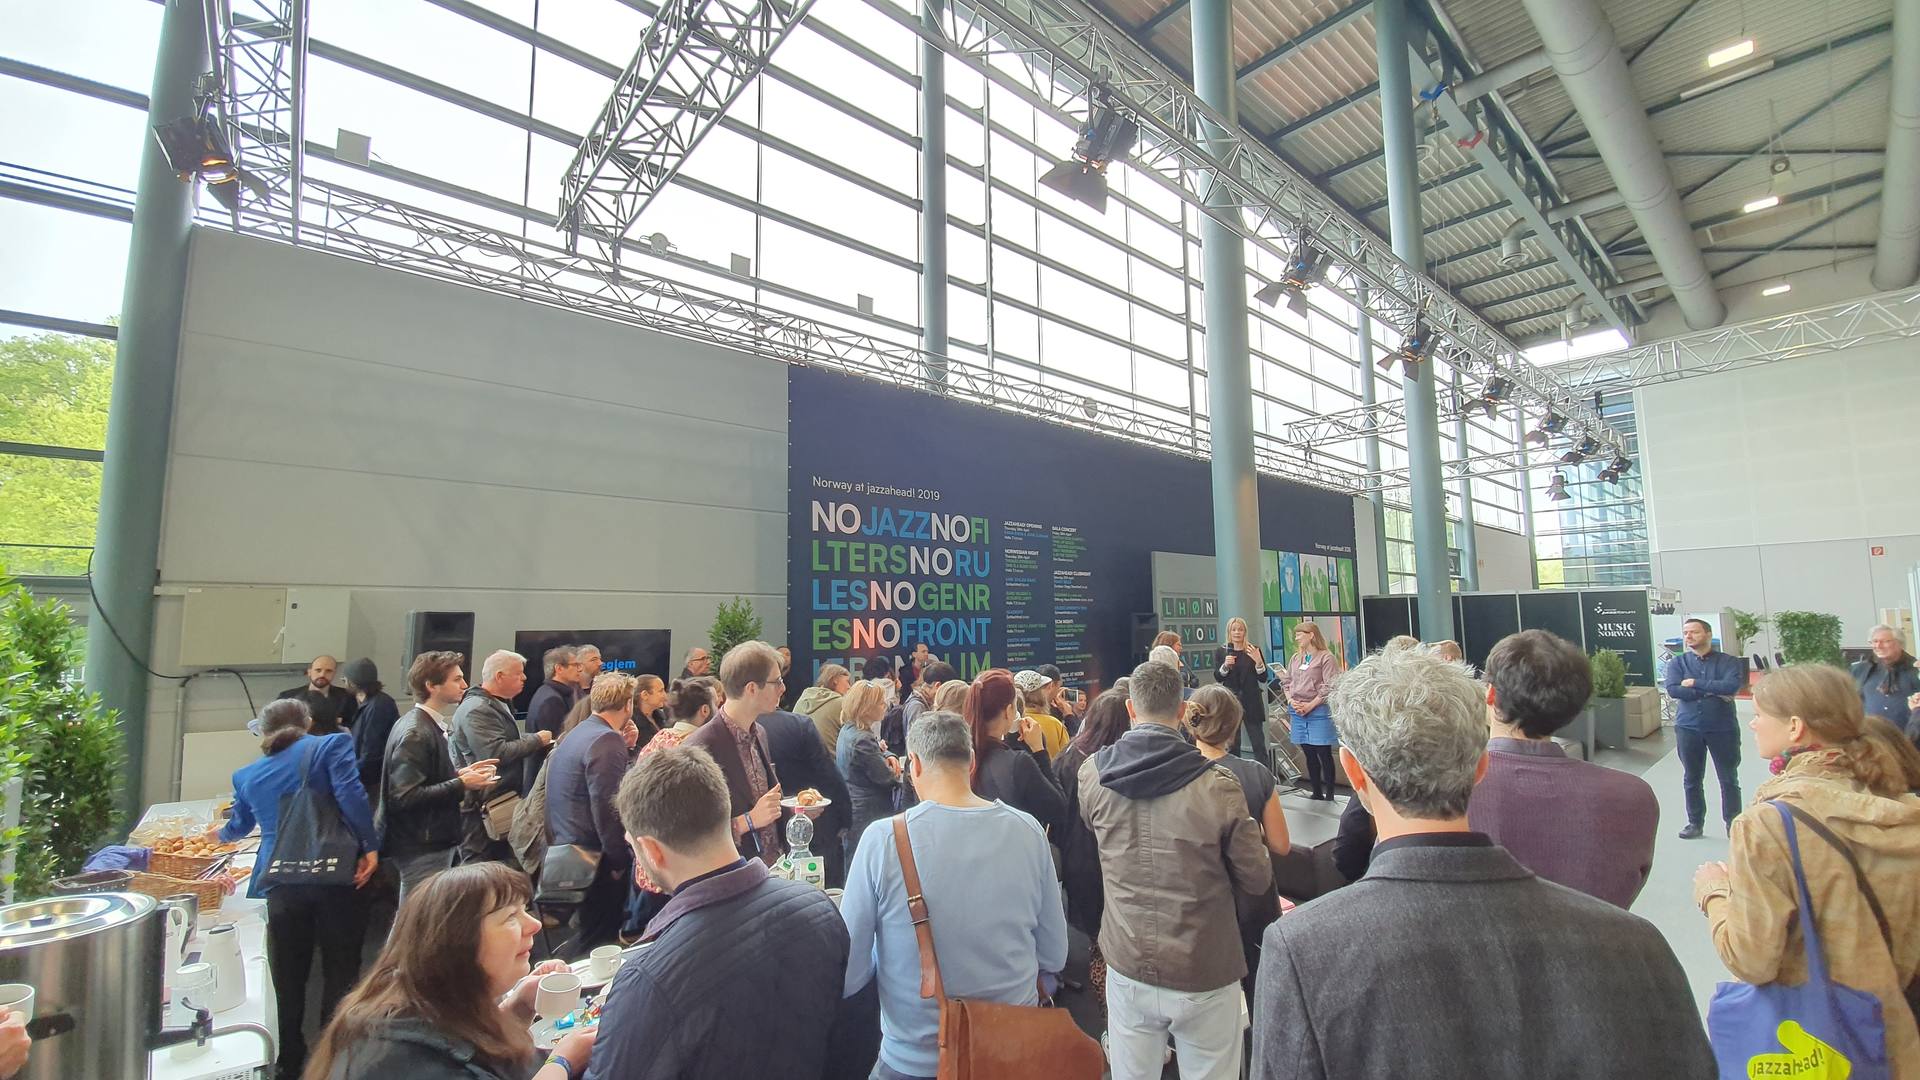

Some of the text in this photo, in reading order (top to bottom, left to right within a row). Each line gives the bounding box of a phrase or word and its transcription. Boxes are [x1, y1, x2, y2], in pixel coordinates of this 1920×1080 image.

[812, 475, 940, 501] Norway at jazzahead! 2019
[812, 500, 990, 545] NOJAZZNOFI
[812, 539, 990, 578] LTERSNORU
[812, 578, 991, 611] LESNOGENR
[812, 617, 992, 651] ESNOFRONT
[1184, 628, 1216, 642] YOU
[1597, 623, 1636, 631] MUSIC
[1751, 1048, 1825, 1078] jazzahead!
